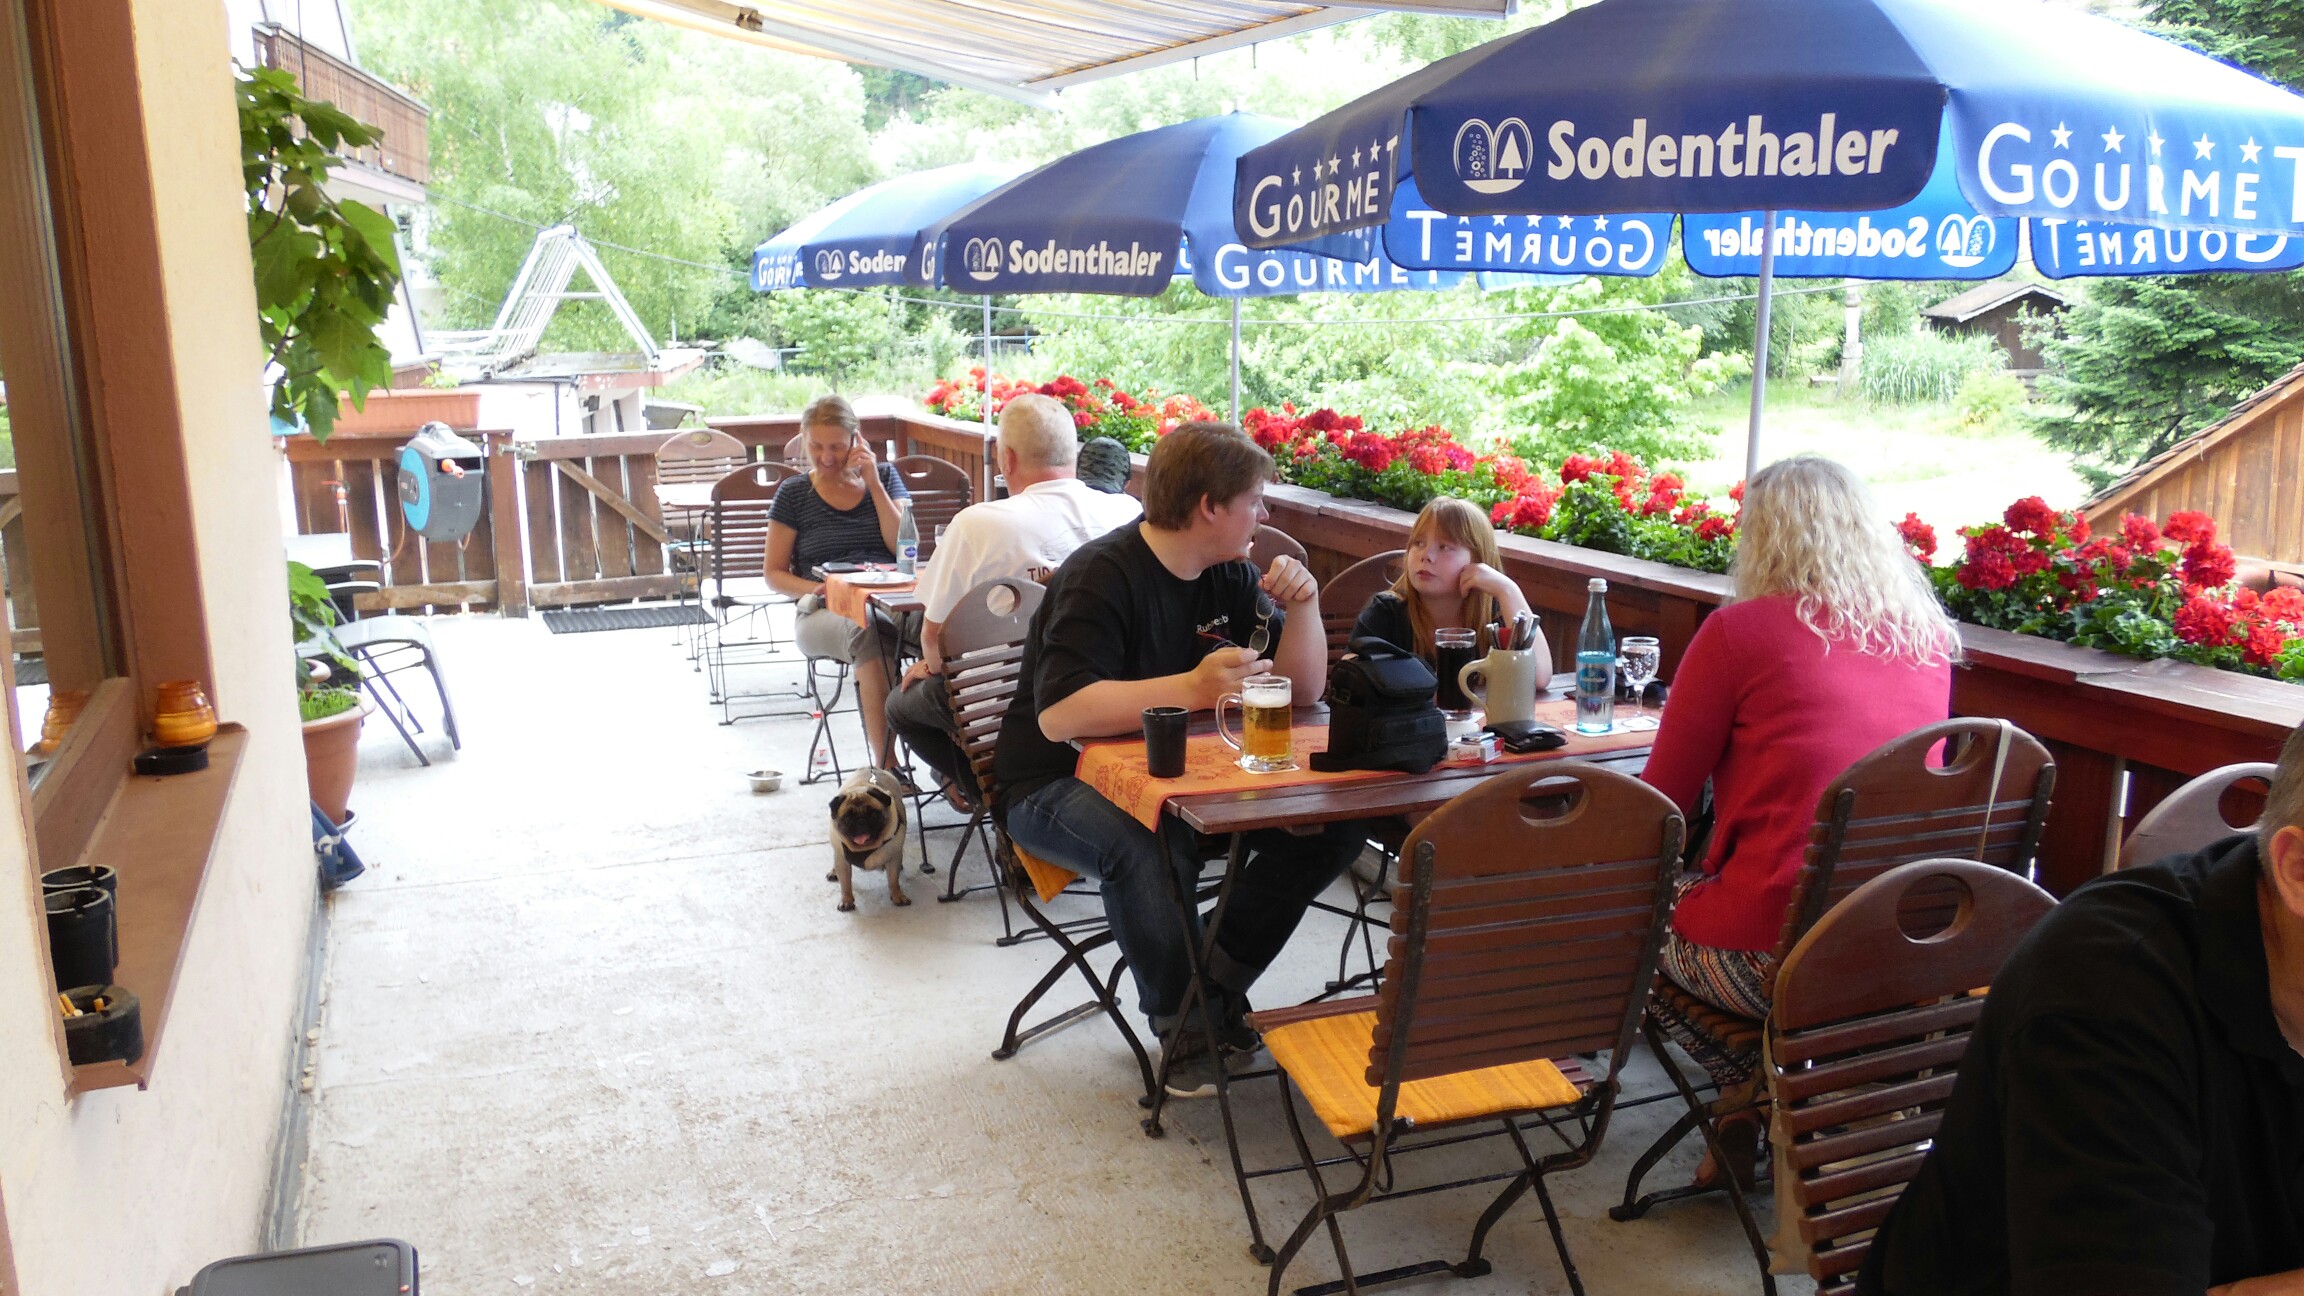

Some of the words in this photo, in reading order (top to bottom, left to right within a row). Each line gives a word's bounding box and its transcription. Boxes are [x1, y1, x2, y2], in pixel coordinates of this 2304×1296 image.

[1249, 135, 1398, 238] GOURMET
[1547, 113, 1899, 180] Sodenthaler
[1978, 122, 2304, 223] GOURMET
[1008, 239, 1162, 277] Sodenthaler
